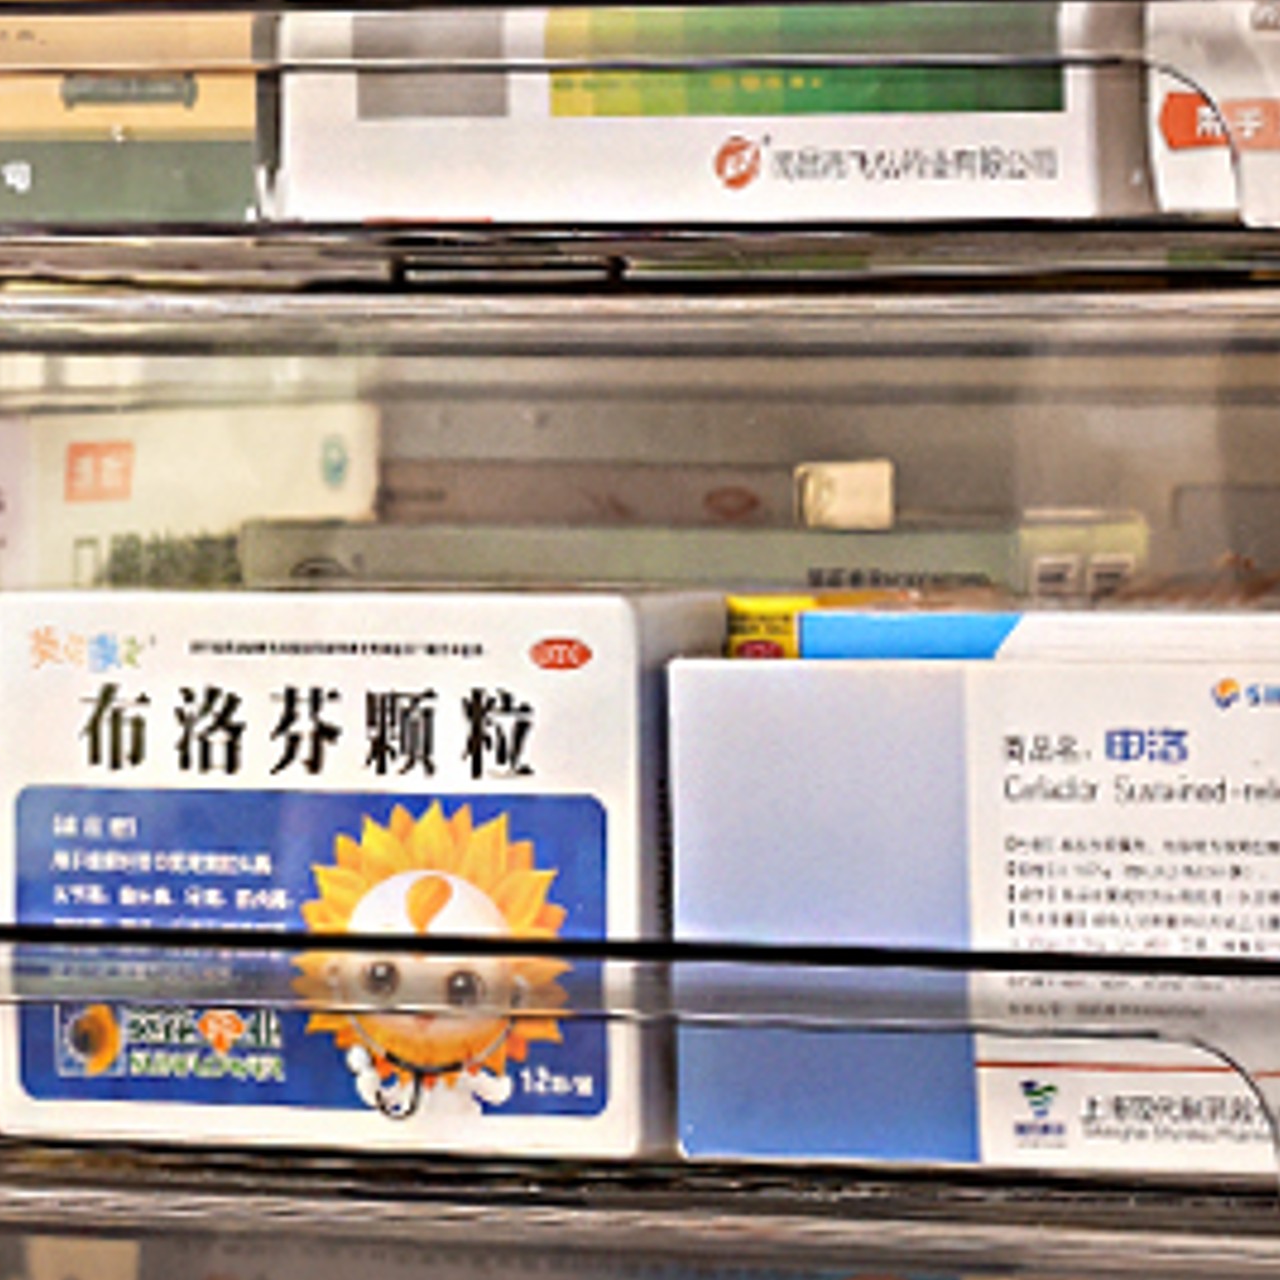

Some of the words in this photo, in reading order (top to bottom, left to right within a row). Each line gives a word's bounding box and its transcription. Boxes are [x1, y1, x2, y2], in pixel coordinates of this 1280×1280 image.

[80, 683, 535, 780] 布洛芬颗粒
